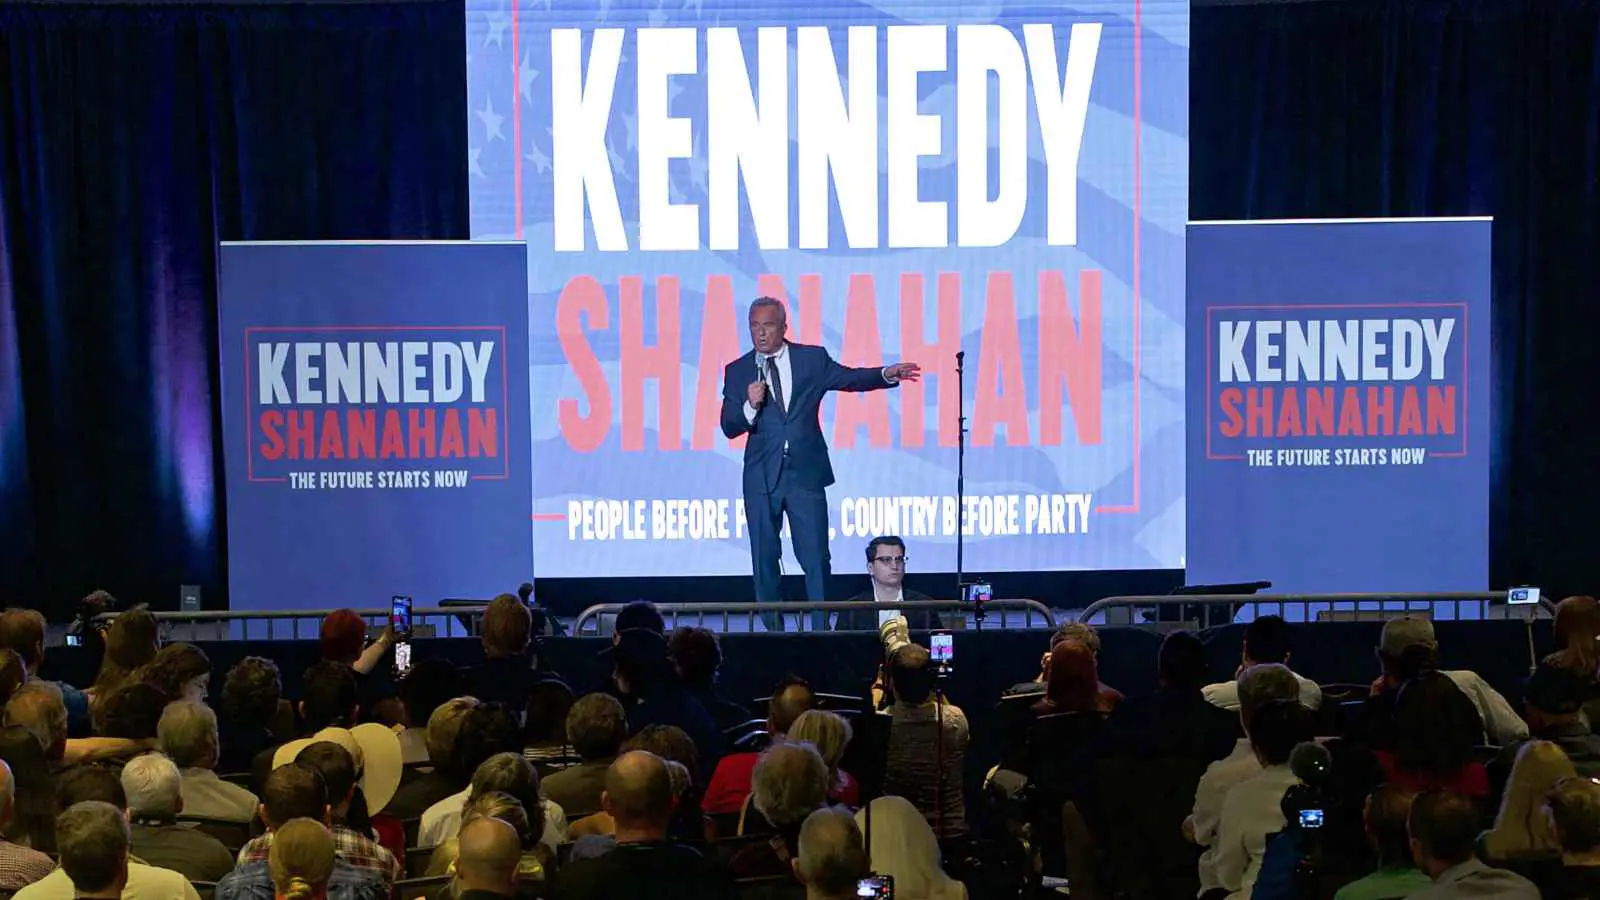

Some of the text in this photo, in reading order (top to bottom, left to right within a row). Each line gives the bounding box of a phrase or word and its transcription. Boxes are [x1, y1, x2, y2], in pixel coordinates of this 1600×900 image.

[551, 23, 1102, 252] KENNEDY
[258, 341, 495, 404] KENNEDY
[1219, 318, 1455, 382] KENNEDY
[259, 408, 497, 460] SHANAHAN
[1219, 385, 1456, 438] SHANAHAN
[289, 470, 468, 489] THE FUTURE STARTS NOW
[1247, 447, 1425, 467] THE FUTURE STARTS NOW
[568, 500, 647, 541] PEOPLE
[652, 498, 730, 540] BEFORE
[841, 496, 939, 537] COUNTRY
[942, 494, 1020, 536] BEFORE
[1025, 493, 1093, 535] PARTY
